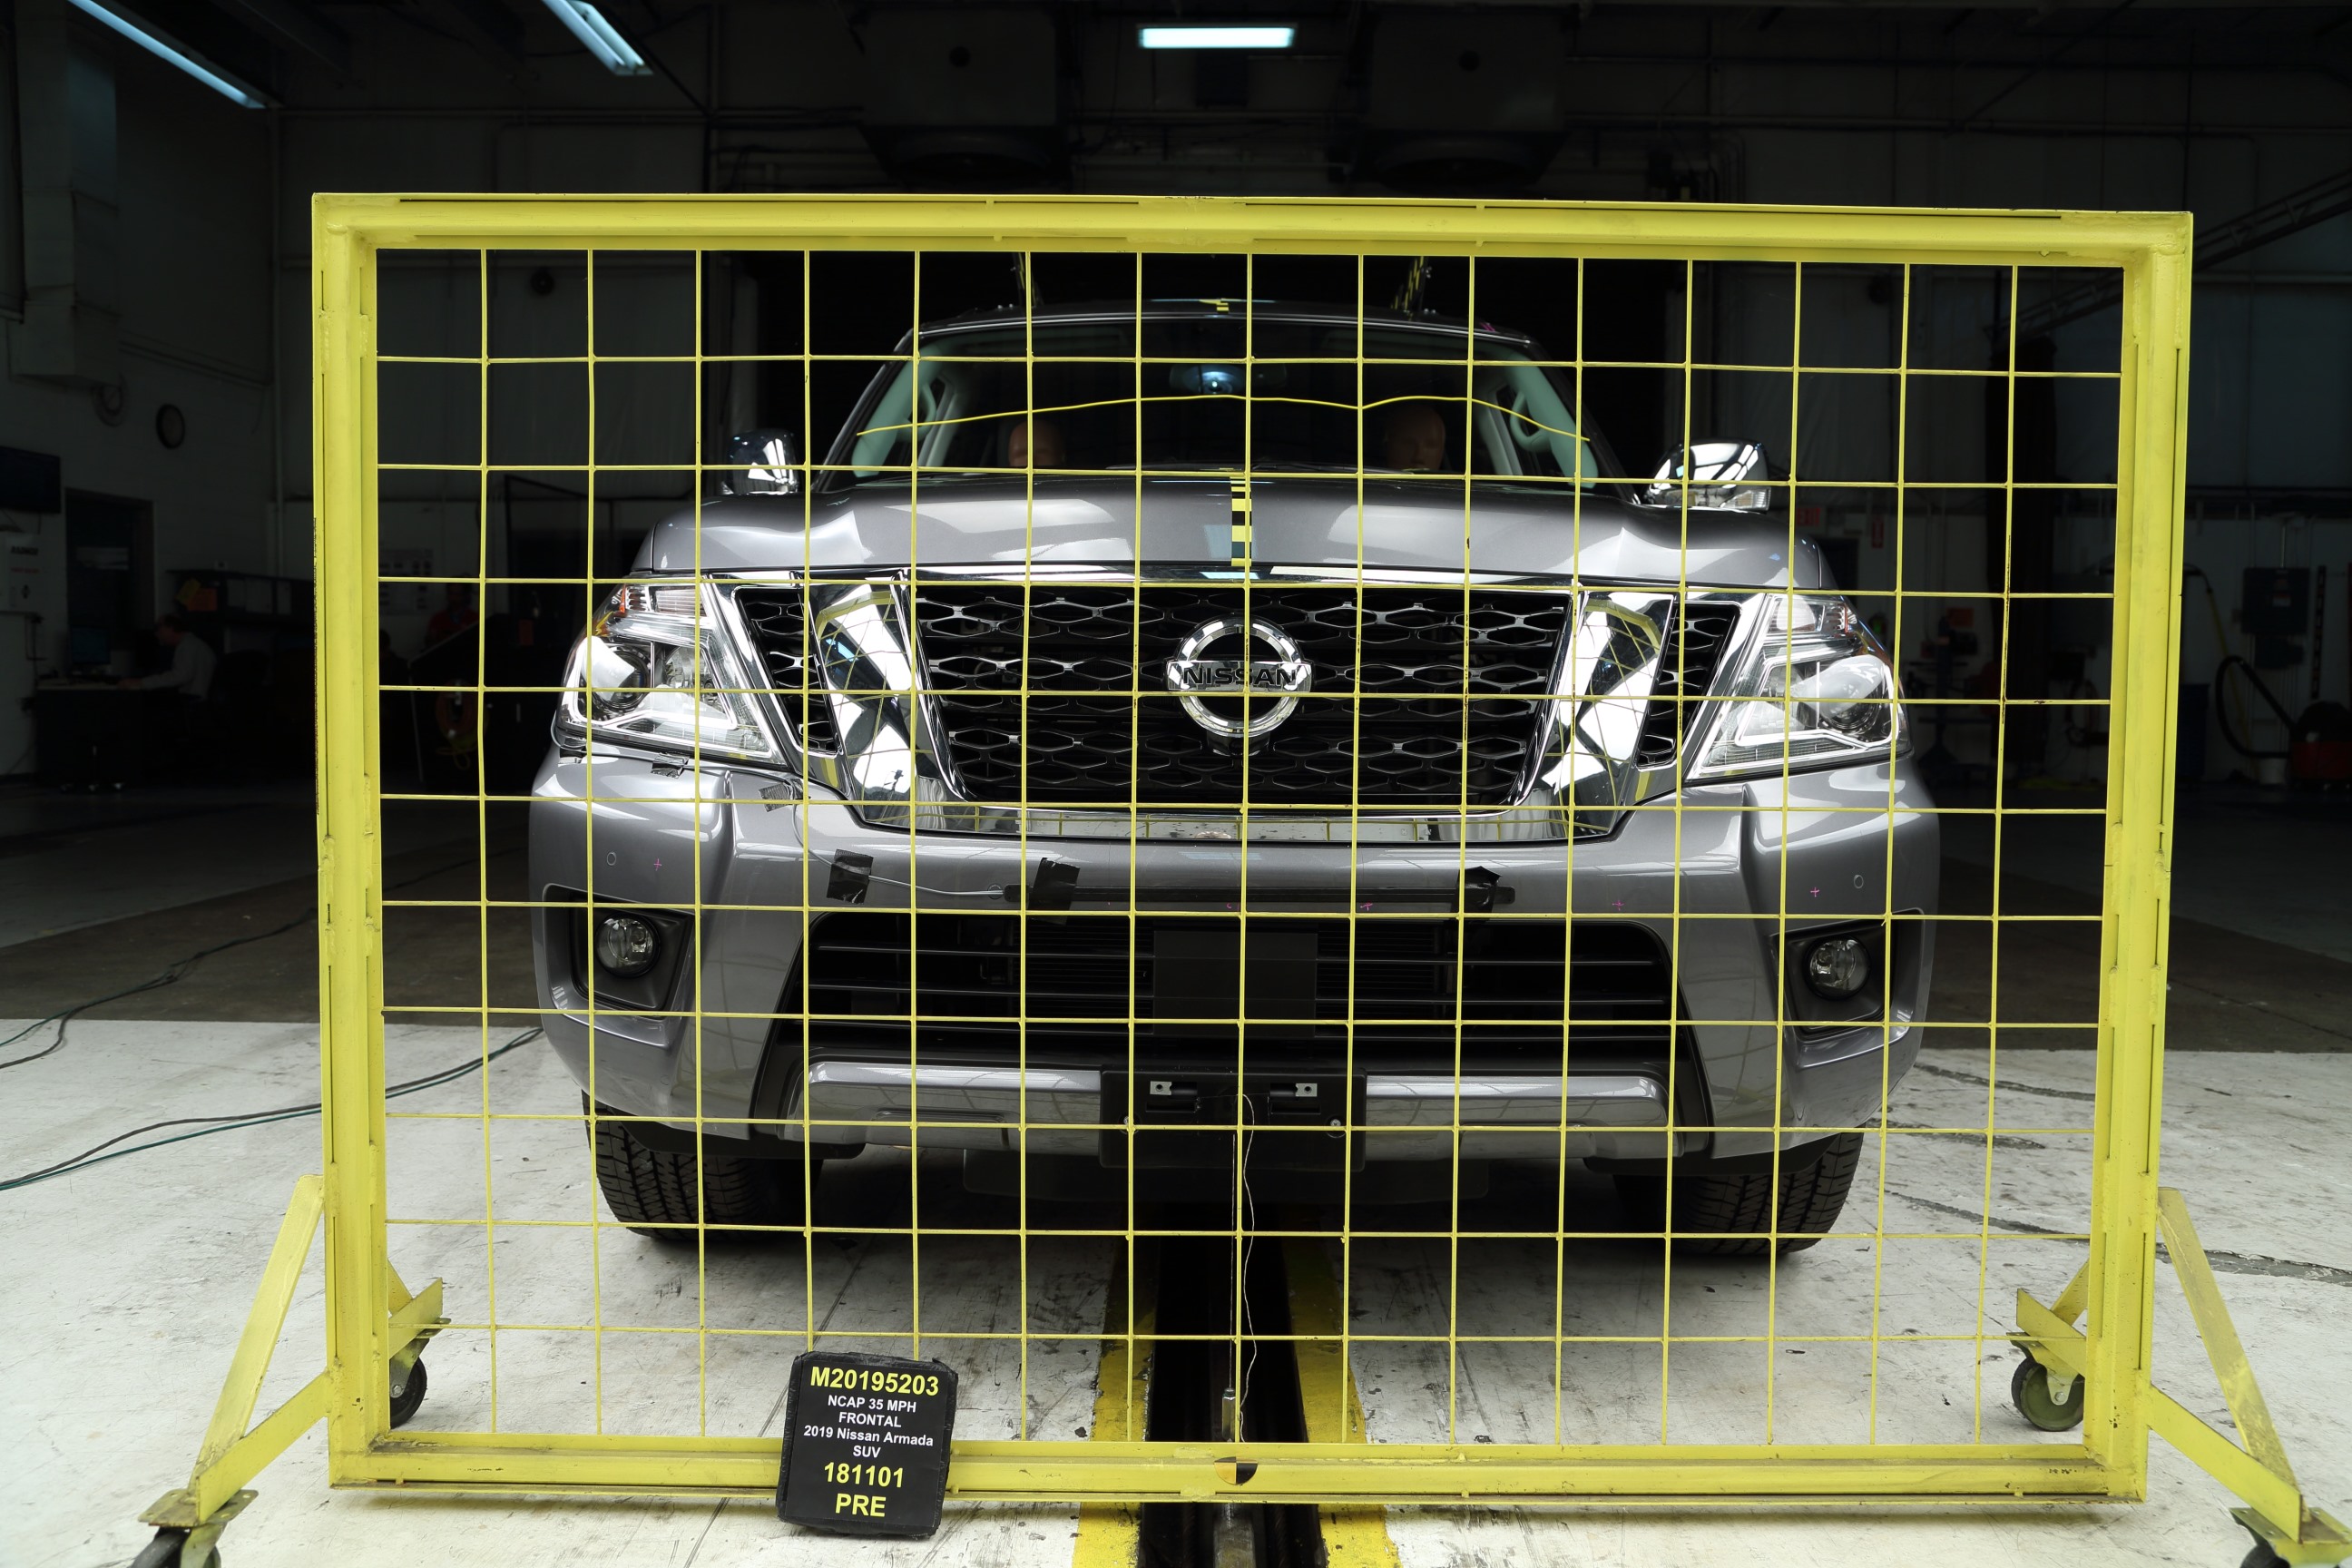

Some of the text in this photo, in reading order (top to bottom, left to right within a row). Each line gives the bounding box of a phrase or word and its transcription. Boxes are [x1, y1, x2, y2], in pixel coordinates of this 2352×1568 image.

[1183, 668, 1296, 685] NISSAN
[810, 1367, 938, 1396] M20195203
[828, 1395, 916, 1413] NCAP 35 MPH
[839, 1412, 901, 1427] FRONTAL
[804, 1425, 933, 1446] 2019 Nissan Armada
[853, 1446, 881, 1457] SUV
[825, 1462, 903, 1487] 181101
[836, 1494, 886, 1517] PRE
